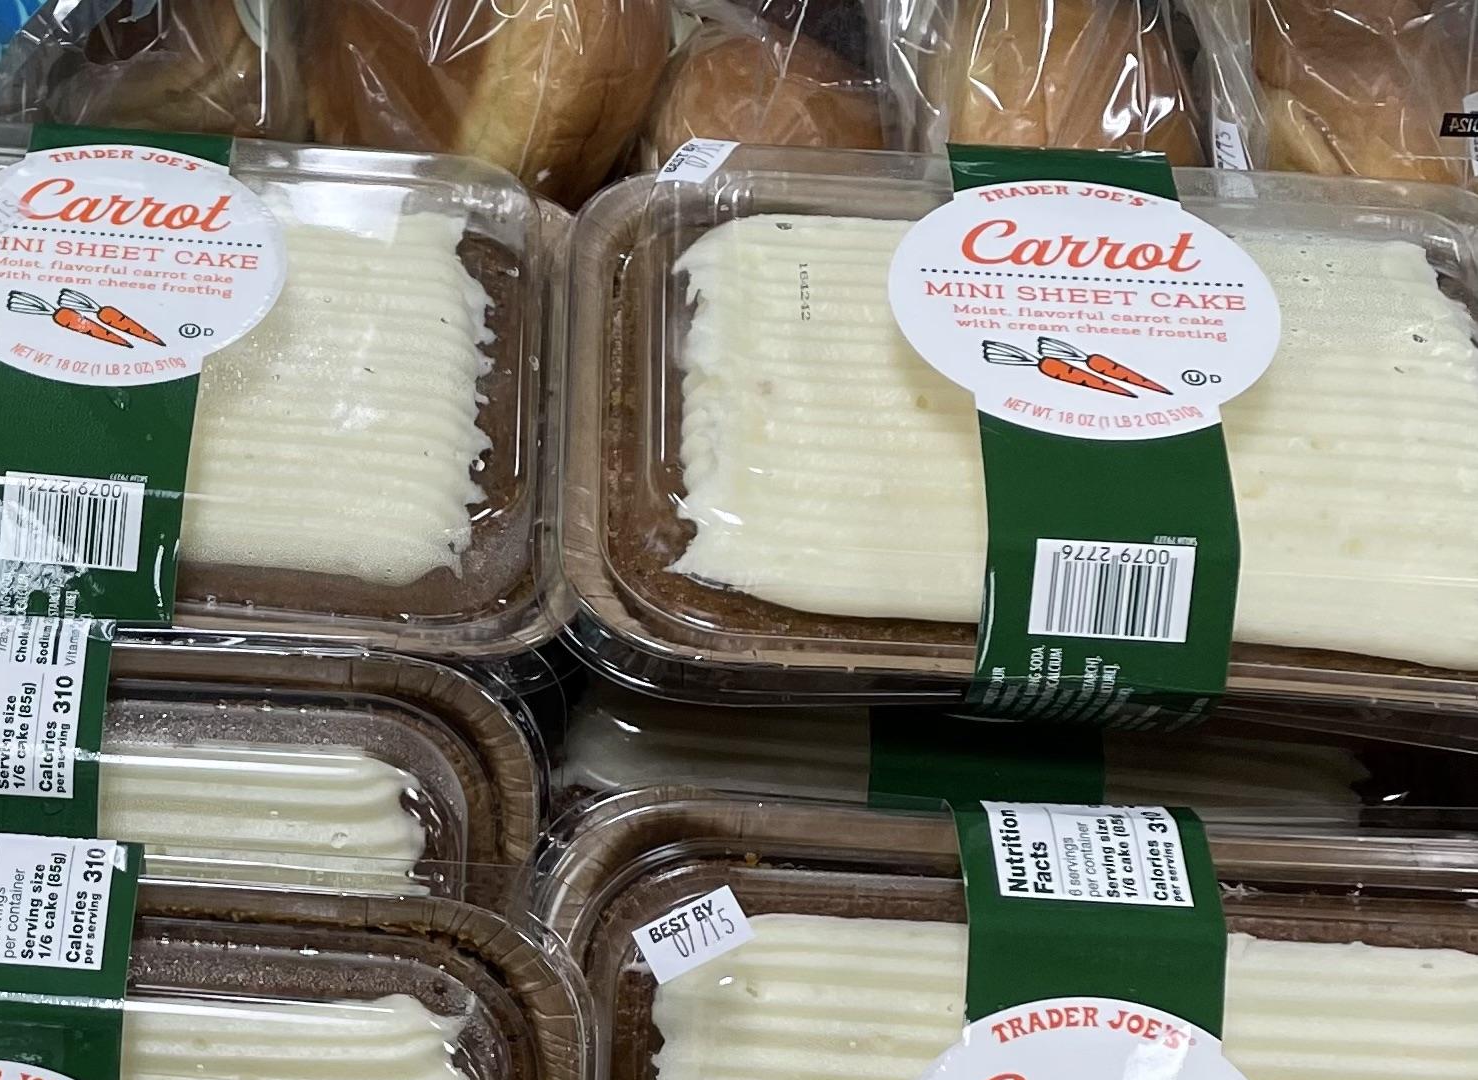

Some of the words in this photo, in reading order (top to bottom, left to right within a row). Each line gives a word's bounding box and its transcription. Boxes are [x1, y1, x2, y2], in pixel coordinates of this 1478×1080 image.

[50, 150, 133, 163] TRADER
[141, 152, 201, 171] JOE'S
[20, 178, 232, 232] Carrot
[980, 184, 1070, 203] TRADER
[1078, 187, 1147, 206] JOE'S
[56, 241, 164, 261] SHEET
[175, 251, 259, 269] CAKE
[961, 219, 1201, 272] Carrot
[38, 273, 92, 286] cream
[98, 277, 156, 290] cheese
[162, 282, 232, 298] frosting
[50, 260, 128, 275] flavorful
[133, 267, 187, 280] carrot
[193, 272, 233, 284] cake
[925, 280, 1006, 298] MINI
[1017, 286, 1138, 306] SHEET
[1151, 292, 1246, 311] CAKE
[957, 318, 1001, 330] with
[1007, 322, 1069, 332] cream
[1076, 325, 1140, 336] cheese
[1148, 327, 1227, 342] frosting
[1019, 307, 1104, 322] flavorful
[1112, 312, 1171, 324] carrot
[1179, 316, 1224, 326] cake
[1062, 545, 1110, 562] 2776
[1120, 548, 1169, 565] 0079
[1001, 809, 1029, 892] Nutrition
[30, 864, 46, 894] size
[49, 852, 67, 887] (85g)
[1031, 841, 1054, 895] Facts
[7, 868, 26, 935] container
[44, 891, 58, 930] cake
[66, 891, 88, 963] Calories
[84, 848, 106, 883] 310
[21, 897, 42, 959] Serving
[88, 893, 102, 944] serving
[649, 912, 689, 943] BEST
[692, 900, 712, 921] BY
[4, 939, 17, 959] per
[38, 933, 53, 959] 1/6
[84, 948, 94, 964] per
[991, 1007, 1098, 1044] TRADER
[1108, 1010, 1190, 1049] JOE'S
